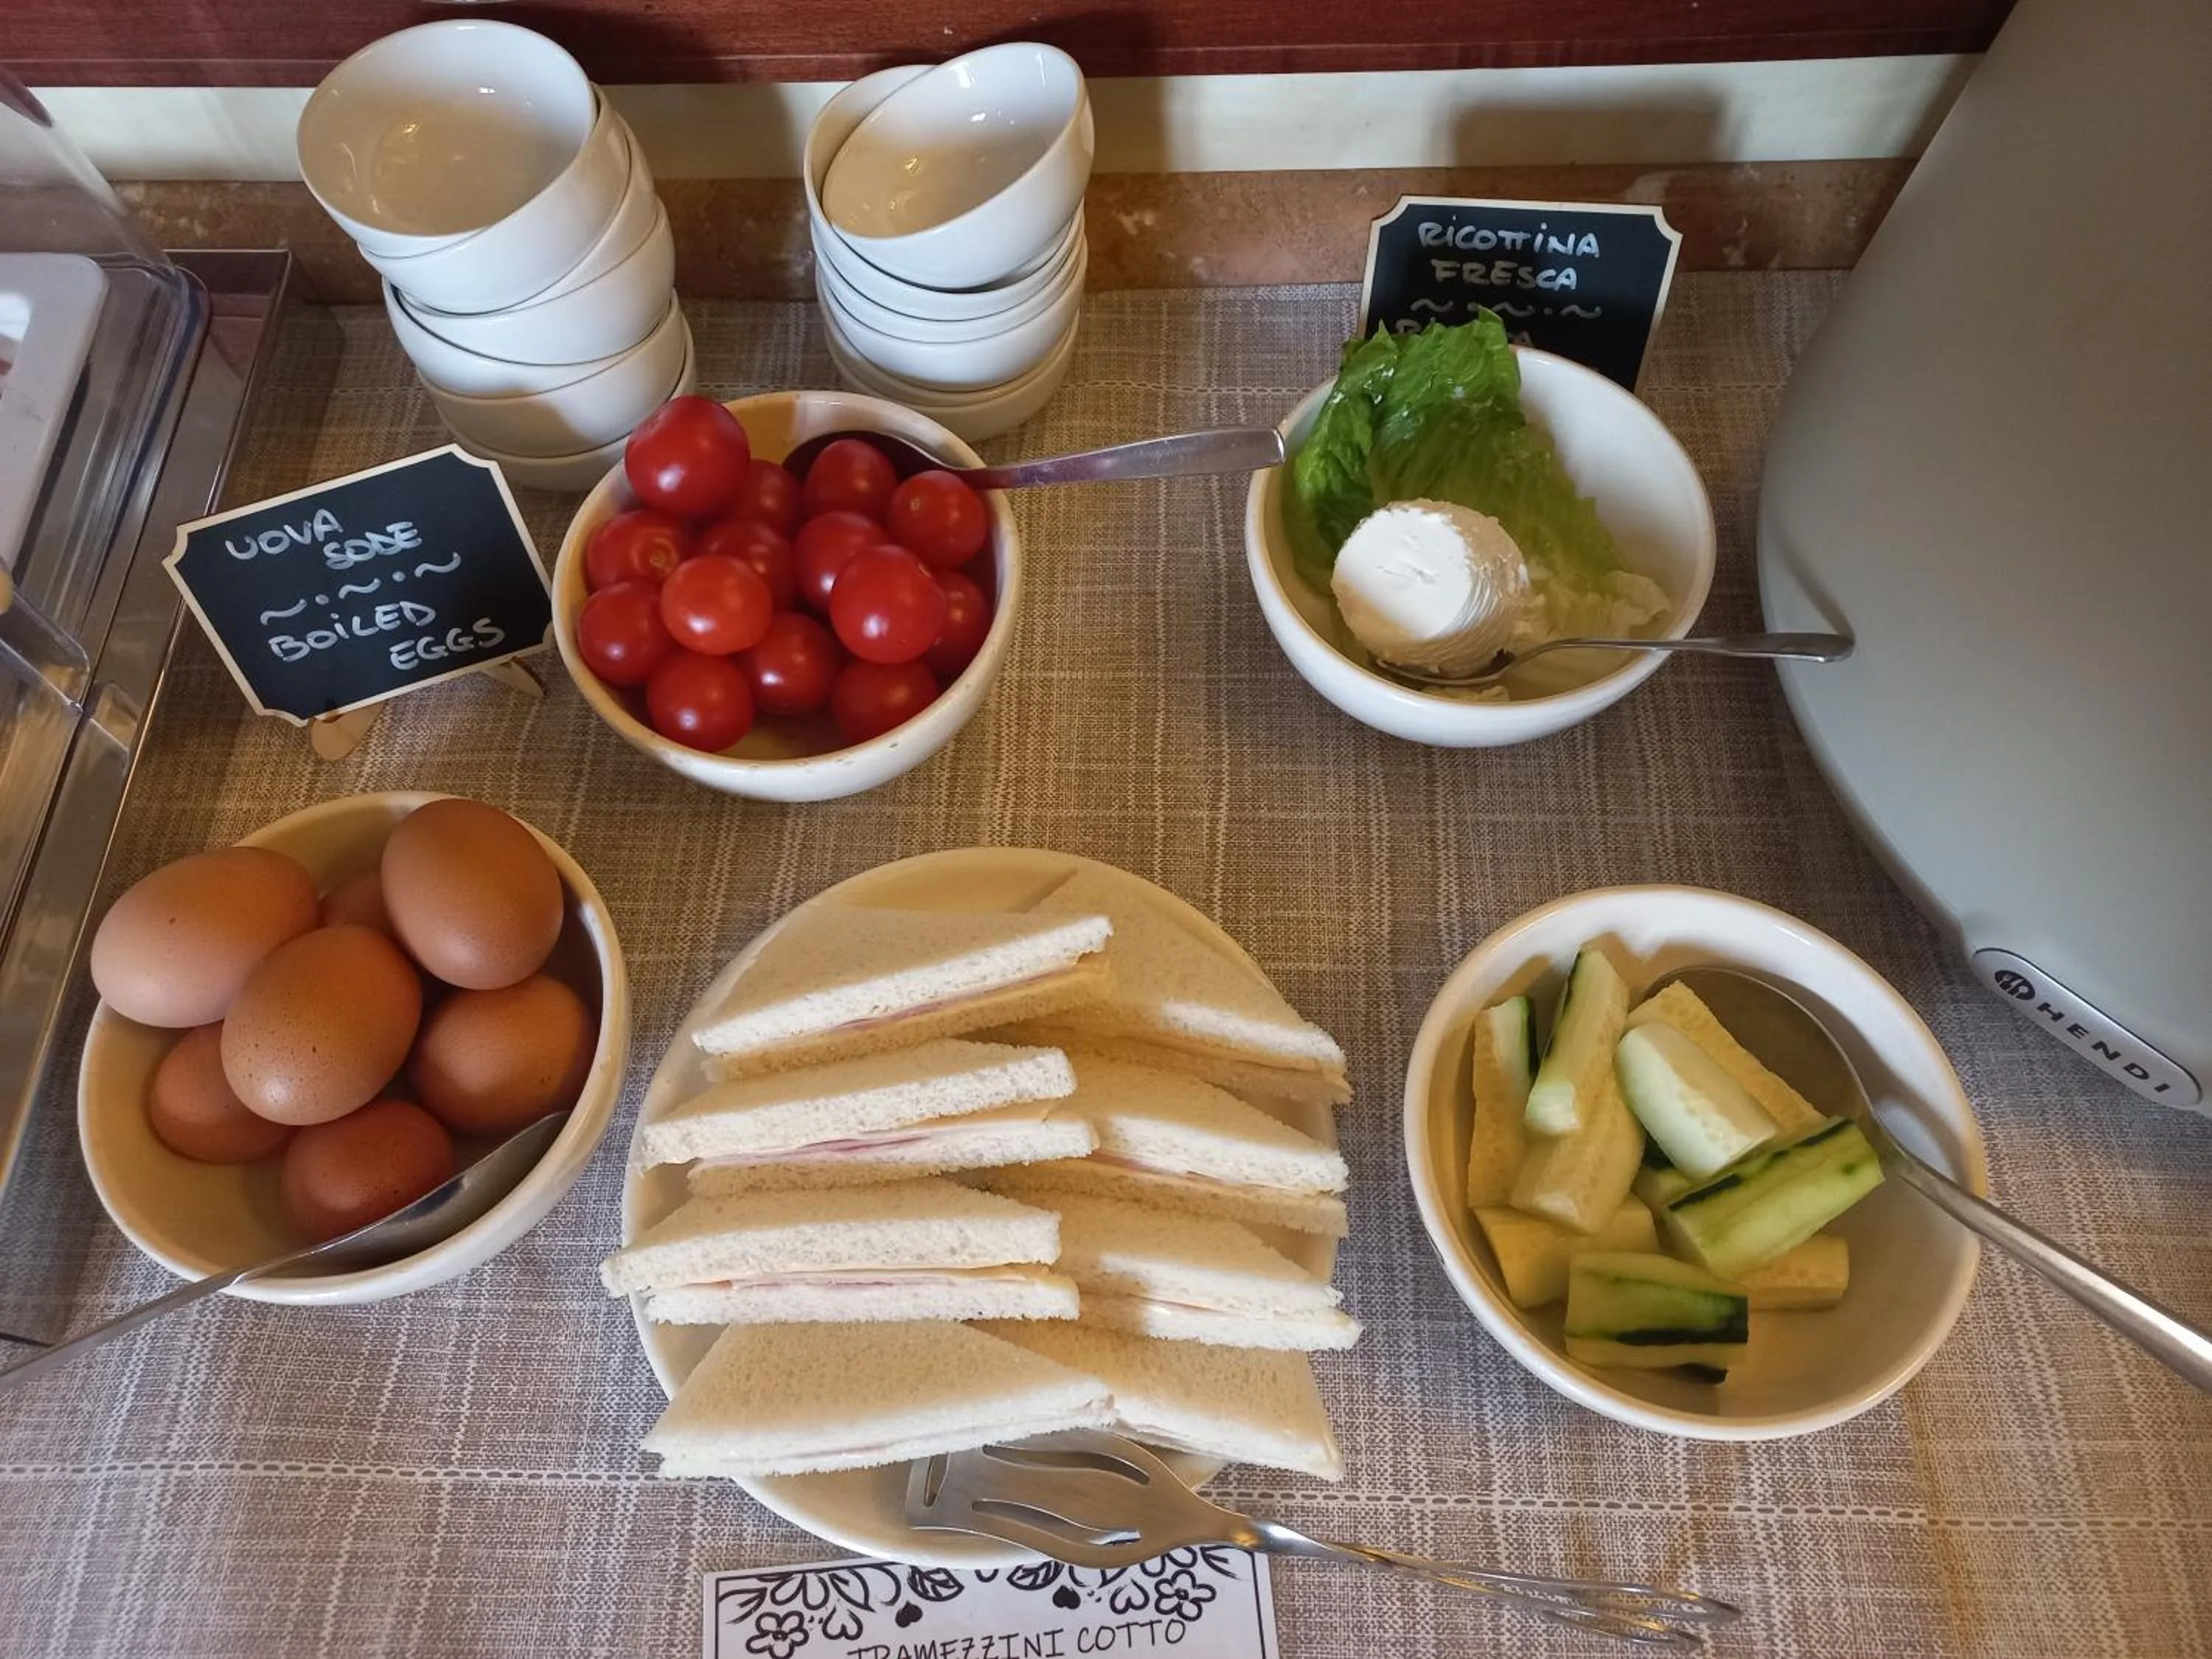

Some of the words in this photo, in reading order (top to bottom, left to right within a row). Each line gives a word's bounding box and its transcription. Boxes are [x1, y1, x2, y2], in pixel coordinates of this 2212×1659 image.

[1430, 258, 1579, 291] FRESCA
[224, 507, 344, 560] UOVA
[323, 521, 423, 571] SODE
[389, 617, 506, 670] EGGS
[2037, 1002, 2171, 1093] HENDI
[1077, 1619, 1186, 1654] COTTO
